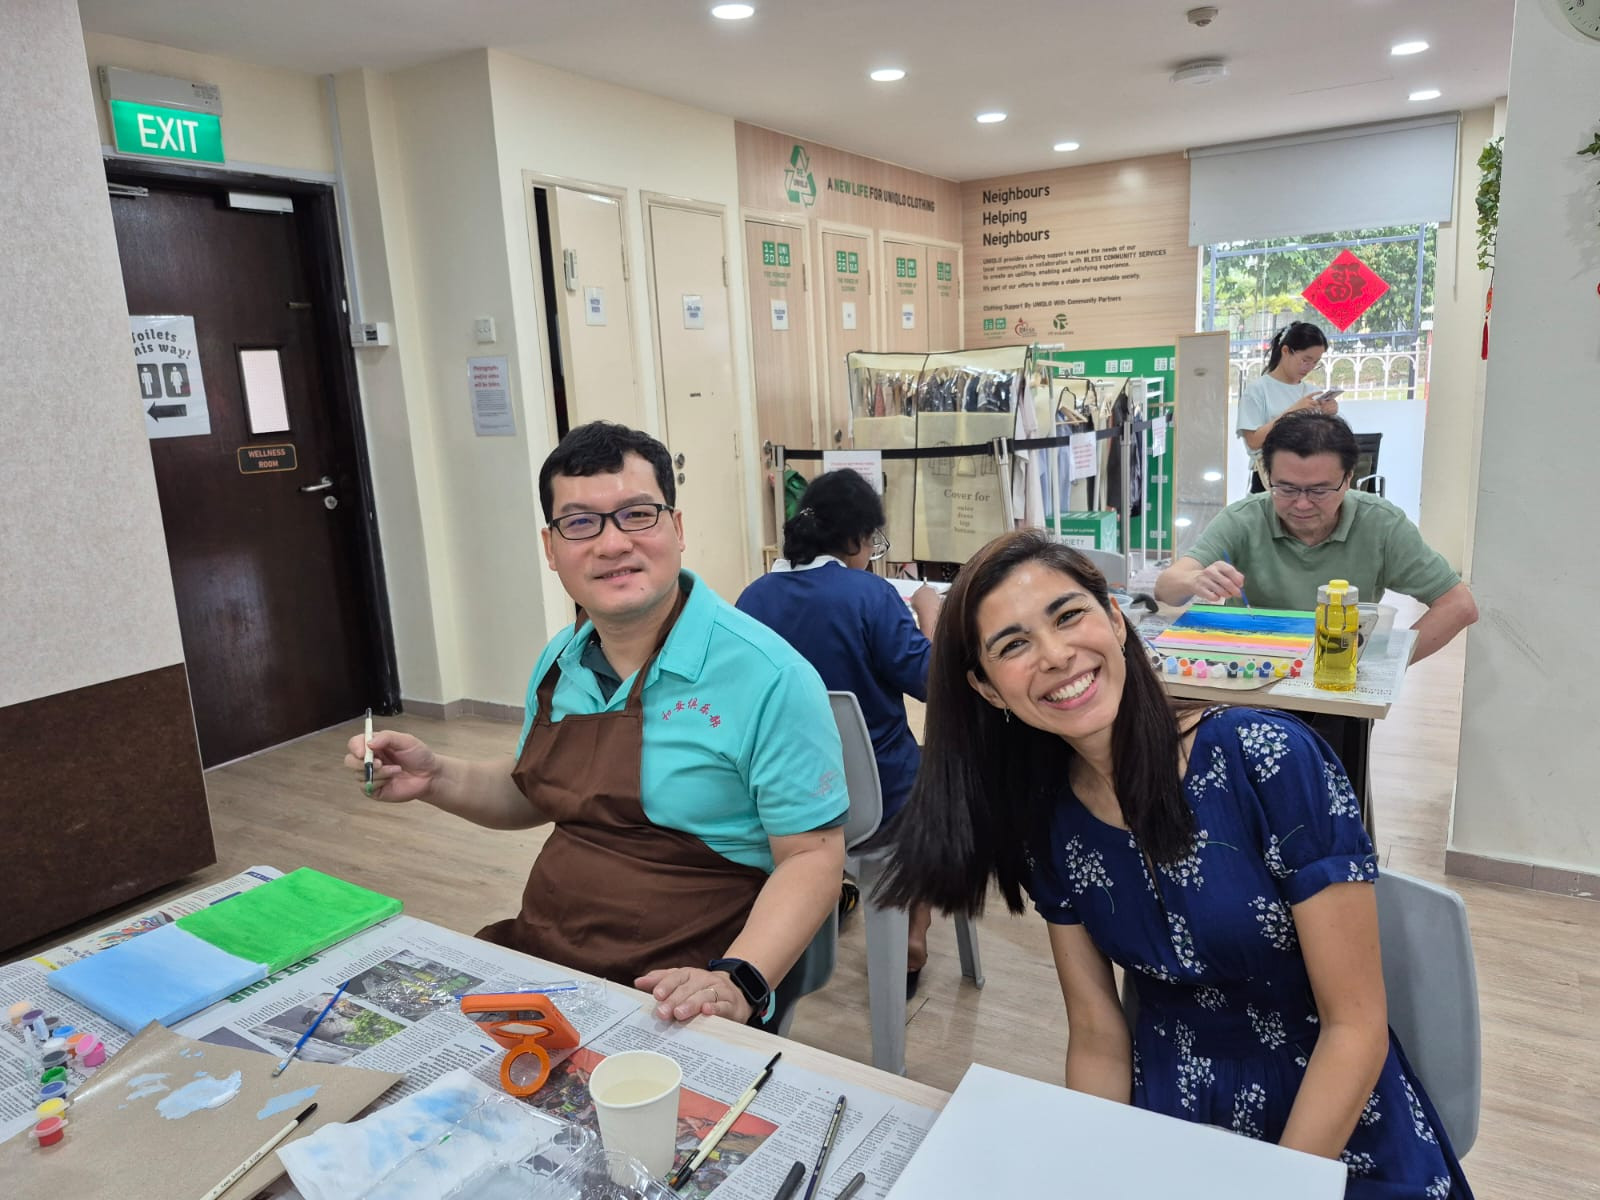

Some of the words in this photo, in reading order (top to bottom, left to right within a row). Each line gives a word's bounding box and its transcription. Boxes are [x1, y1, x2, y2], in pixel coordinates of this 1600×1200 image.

[137, 113, 198, 153] EXIT
[828, 177, 833, 190] A
[834, 178, 850, 194] NEW
[852, 182, 868, 198] LIFE
[870, 186, 882, 201] FOR
[884, 190, 906, 207] UNIQLO
[907, 195, 935, 212] CLOTHING
[983, 185, 1050, 205] Neighbours
[983, 210, 1027, 227] Helping
[983, 228, 1050, 247] Neighbours
[1104, 252, 1136, 260] COMMUNITY
[135, 343, 154, 356] his
[159, 344, 191, 359] way!
[248, 449, 285, 458] WELLNESS
[944, 489, 972, 500] Cover
[975, 491, 990, 501] for
[229, 976, 283, 1004] YOUR
